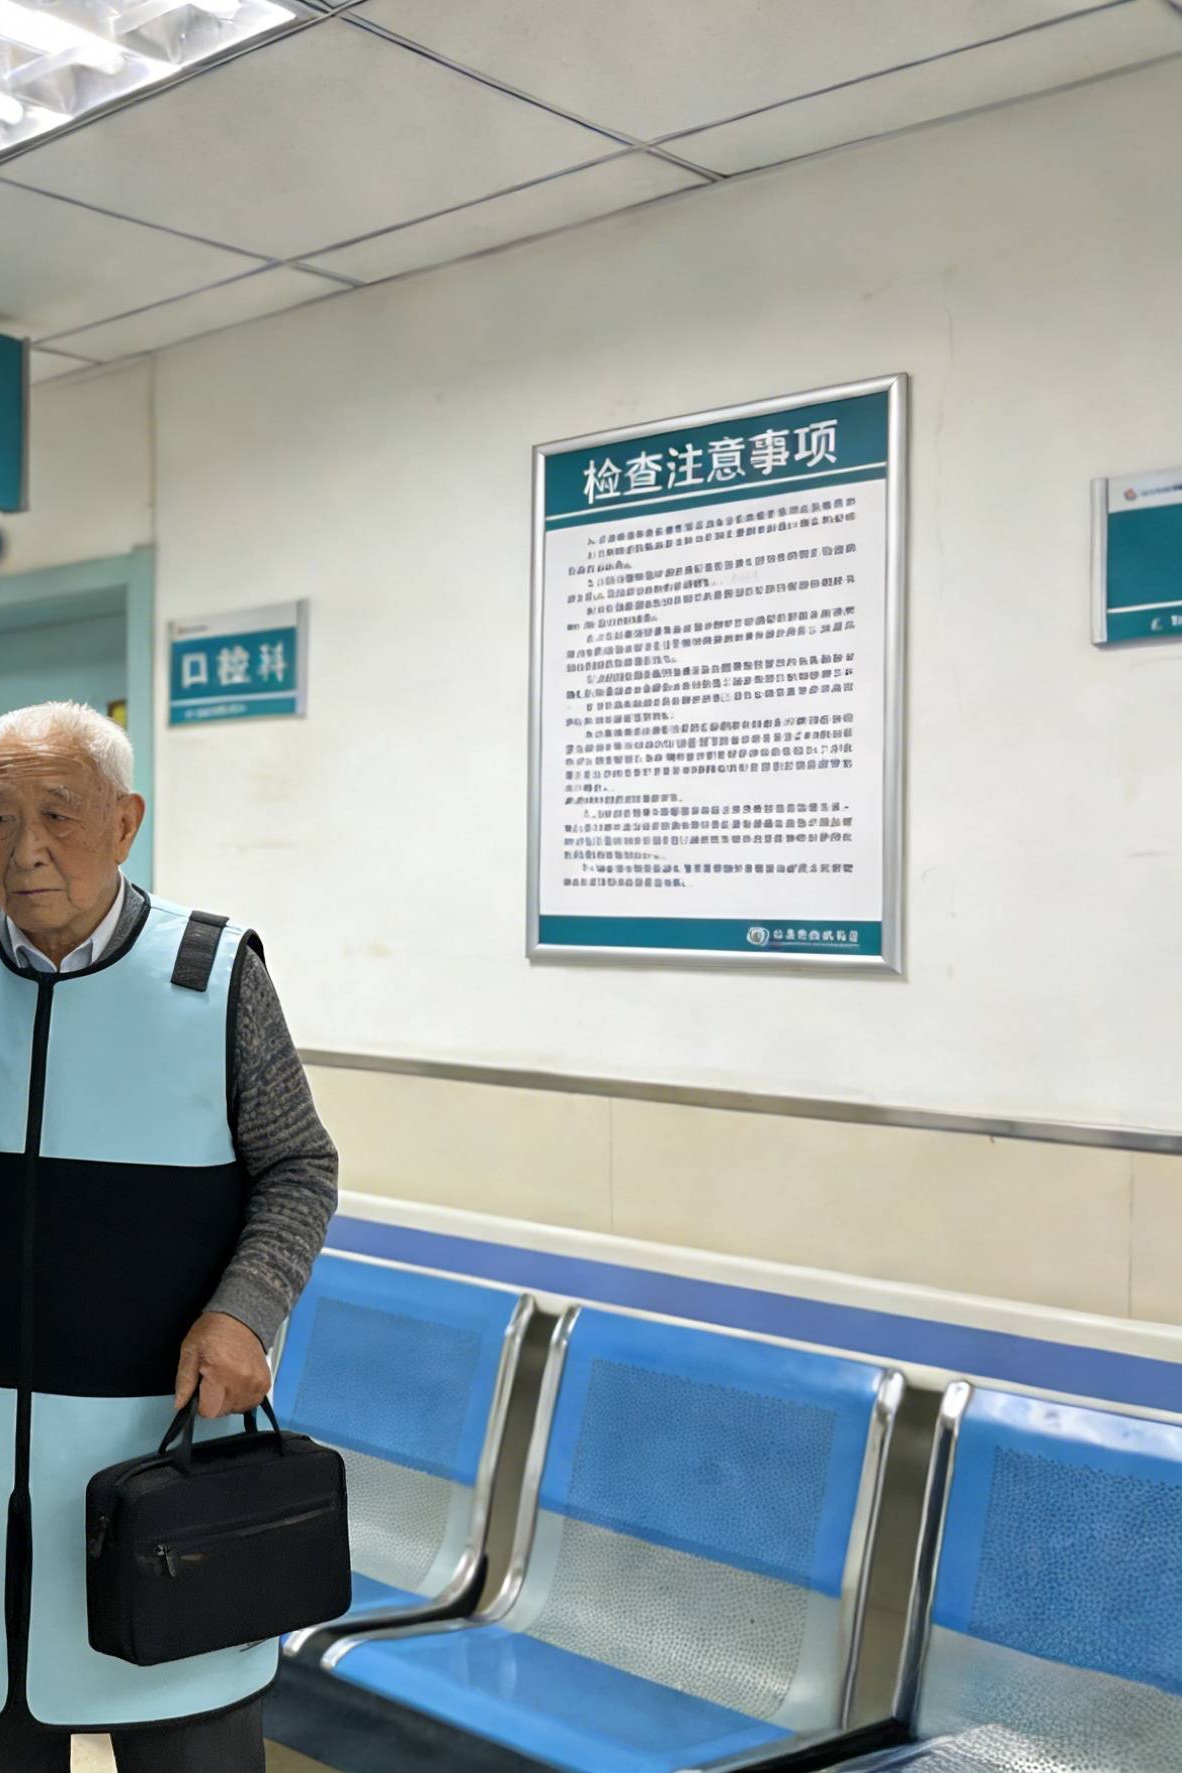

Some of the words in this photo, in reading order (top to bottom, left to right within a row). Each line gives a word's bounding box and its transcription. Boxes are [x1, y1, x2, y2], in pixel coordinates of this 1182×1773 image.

[583, 418, 839, 505] 检查注意事项
